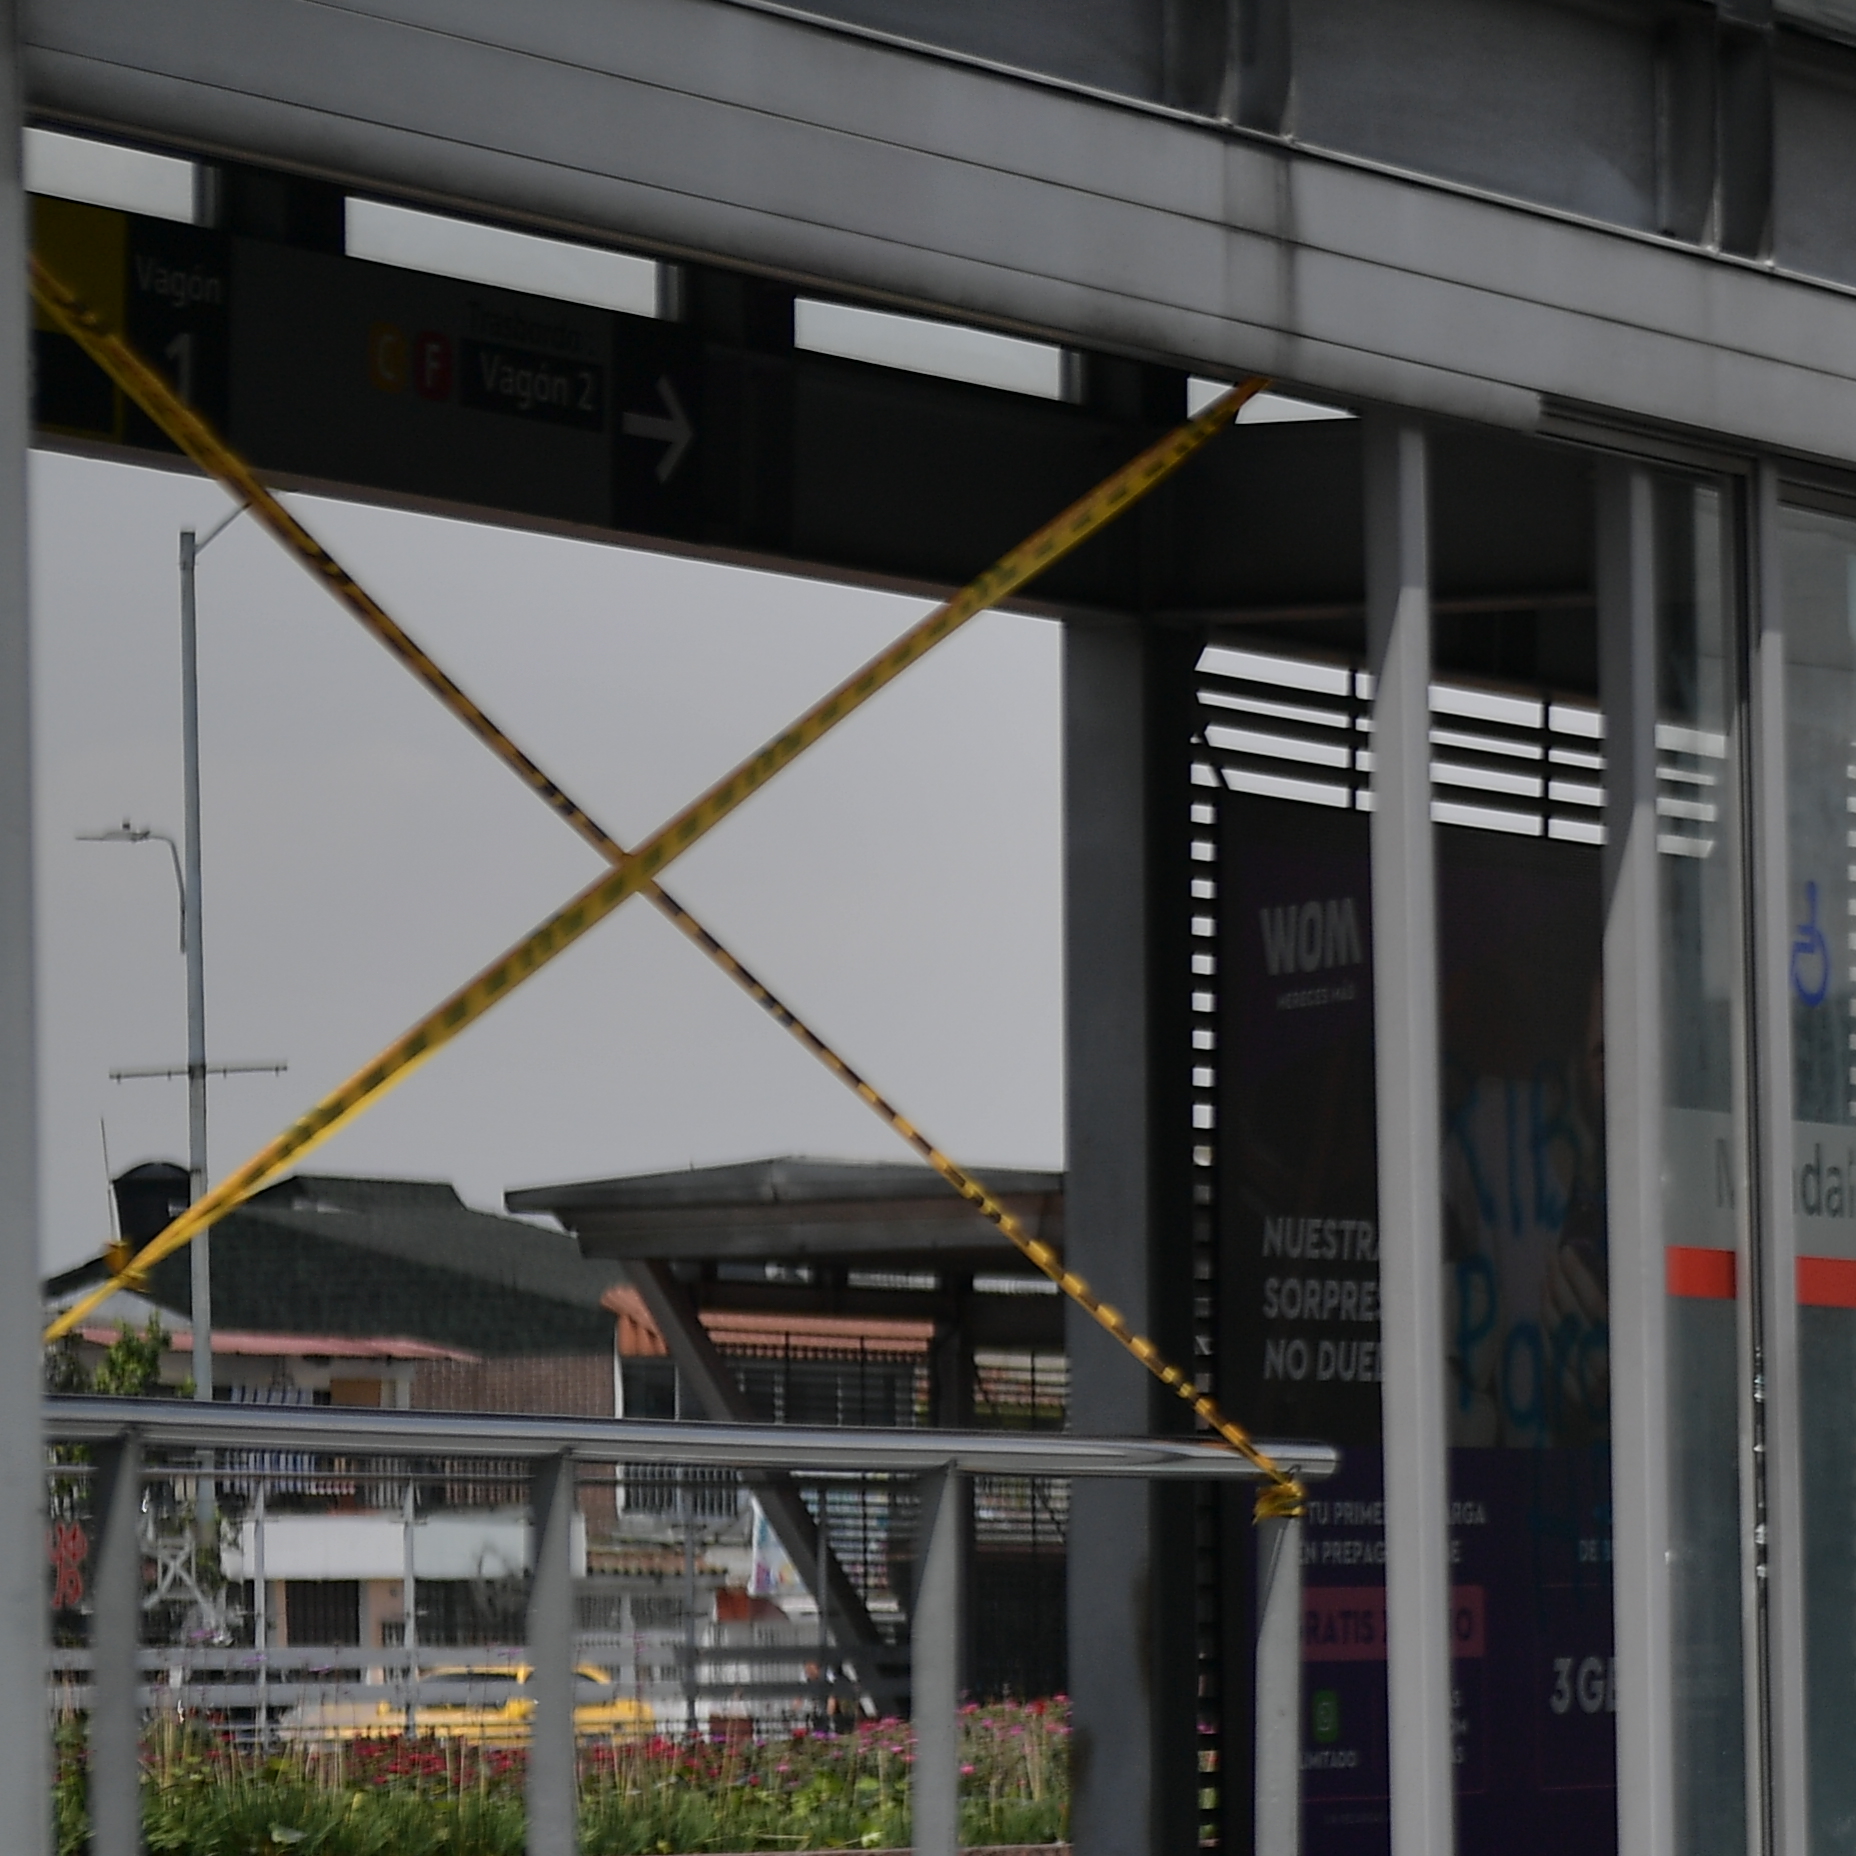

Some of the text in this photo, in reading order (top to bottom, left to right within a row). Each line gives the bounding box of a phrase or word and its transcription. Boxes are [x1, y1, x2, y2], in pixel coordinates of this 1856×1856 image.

[135, 254, 222, 308] Vagón
[164, 332, 196, 409] 1
[480, 351, 595, 411] Vagón 2
[1259, 897, 1362, 977] WOM
[1262, 1276, 1380, 1322] SORPRE
[1262, 1338, 1308, 1381] NO
[1307, 1500, 1328, 1525] TU
[1305, 1609, 1375, 1646] RATIS
